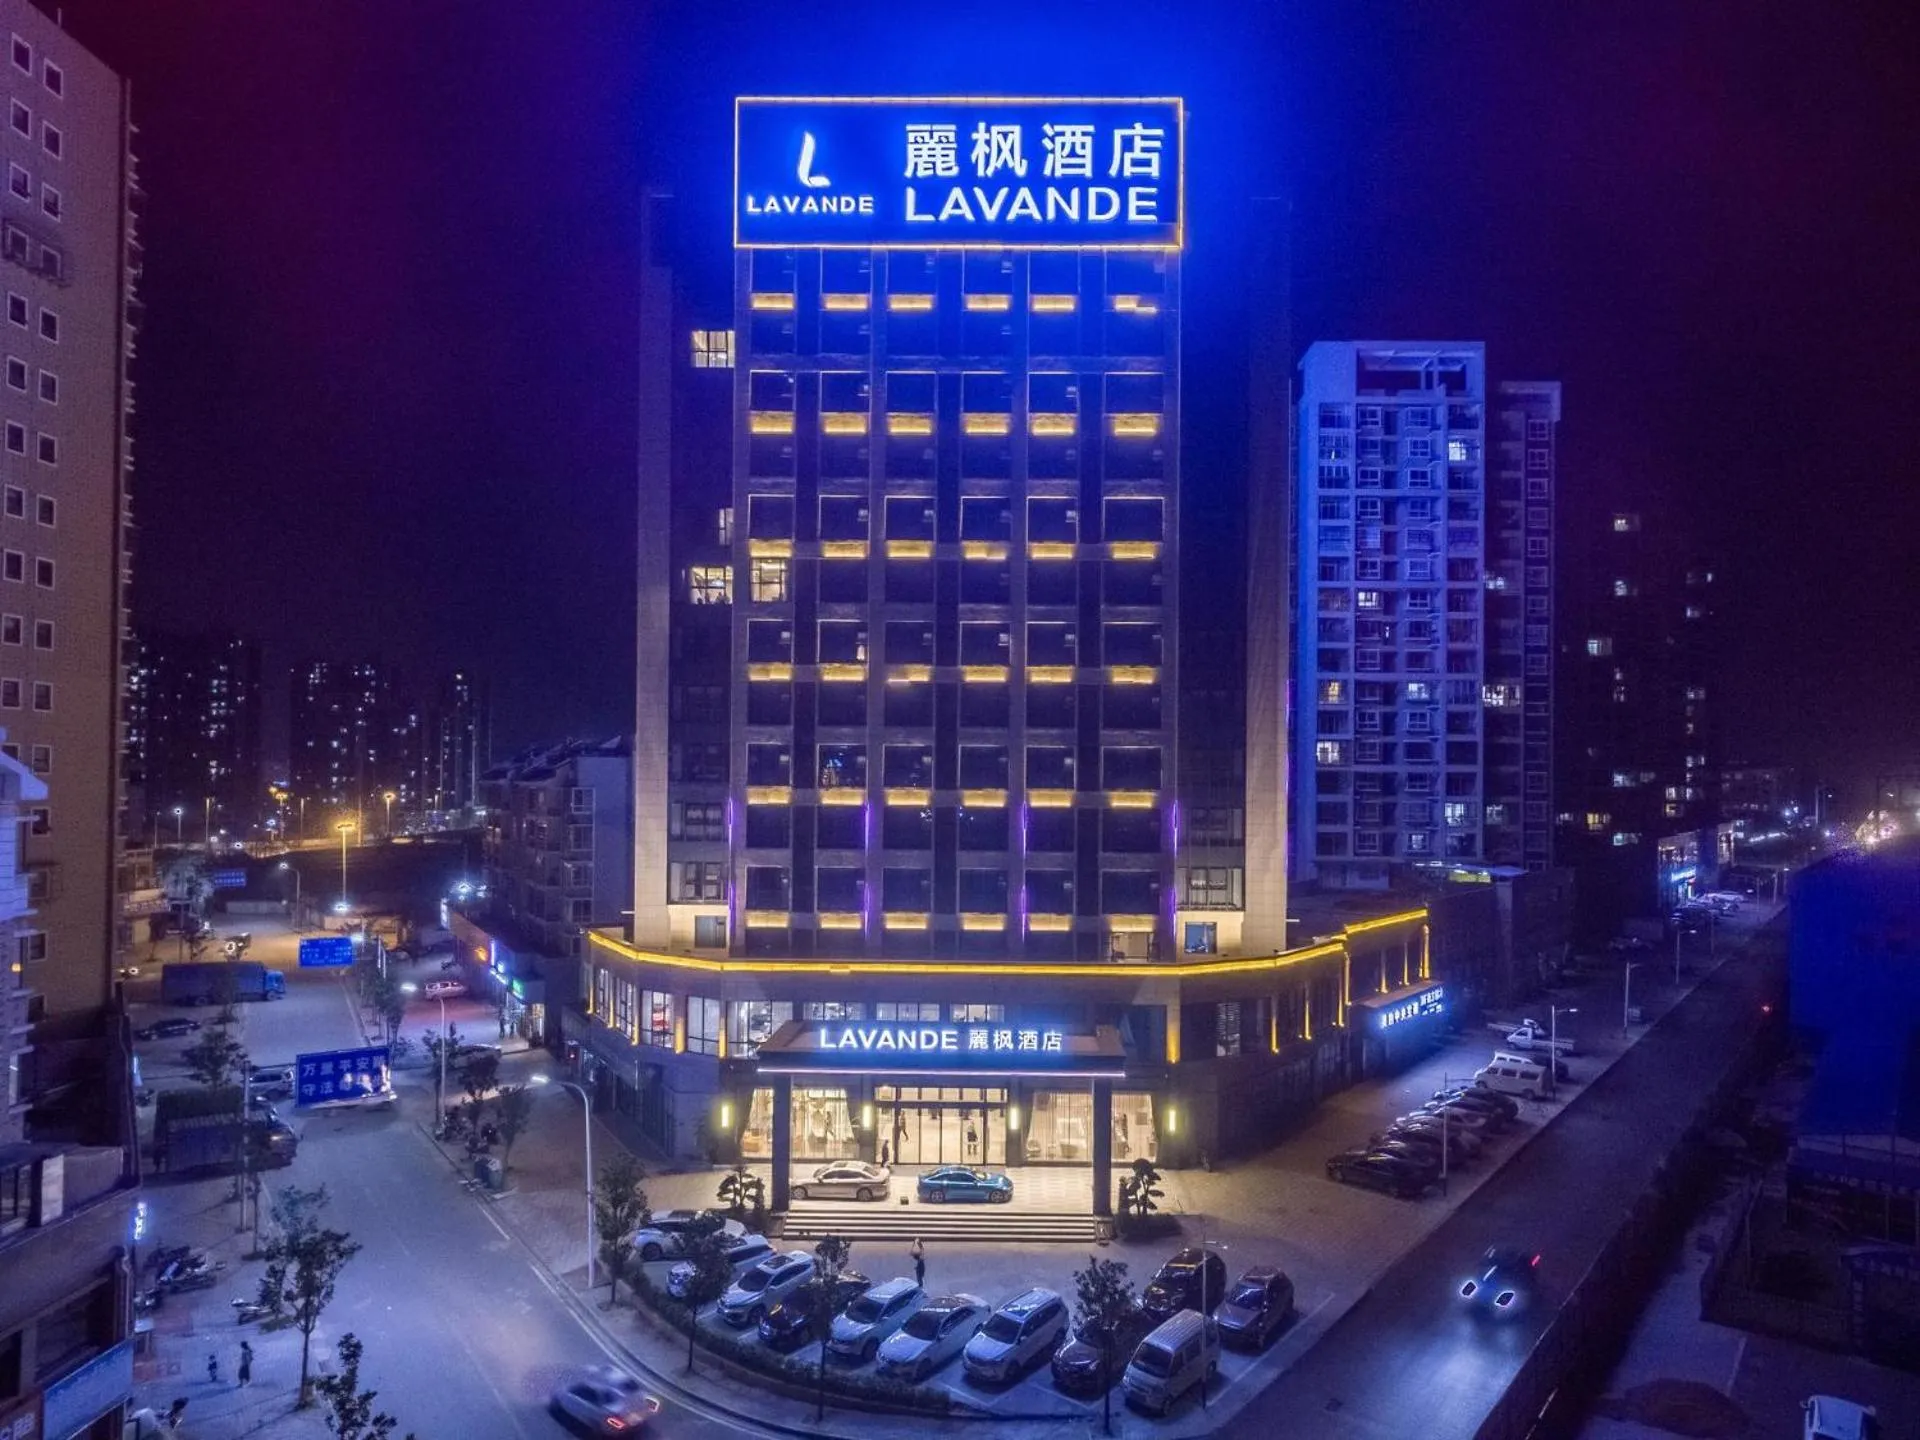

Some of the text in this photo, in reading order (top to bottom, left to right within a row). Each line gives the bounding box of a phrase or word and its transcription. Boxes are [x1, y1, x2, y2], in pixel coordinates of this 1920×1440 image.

[904, 122, 1165, 178] 麗枫酒店
[747, 195, 874, 214] LAVANDE
[904, 187, 1159, 222] LAVANDE
[819, 1028, 958, 1051] LAVANDE
